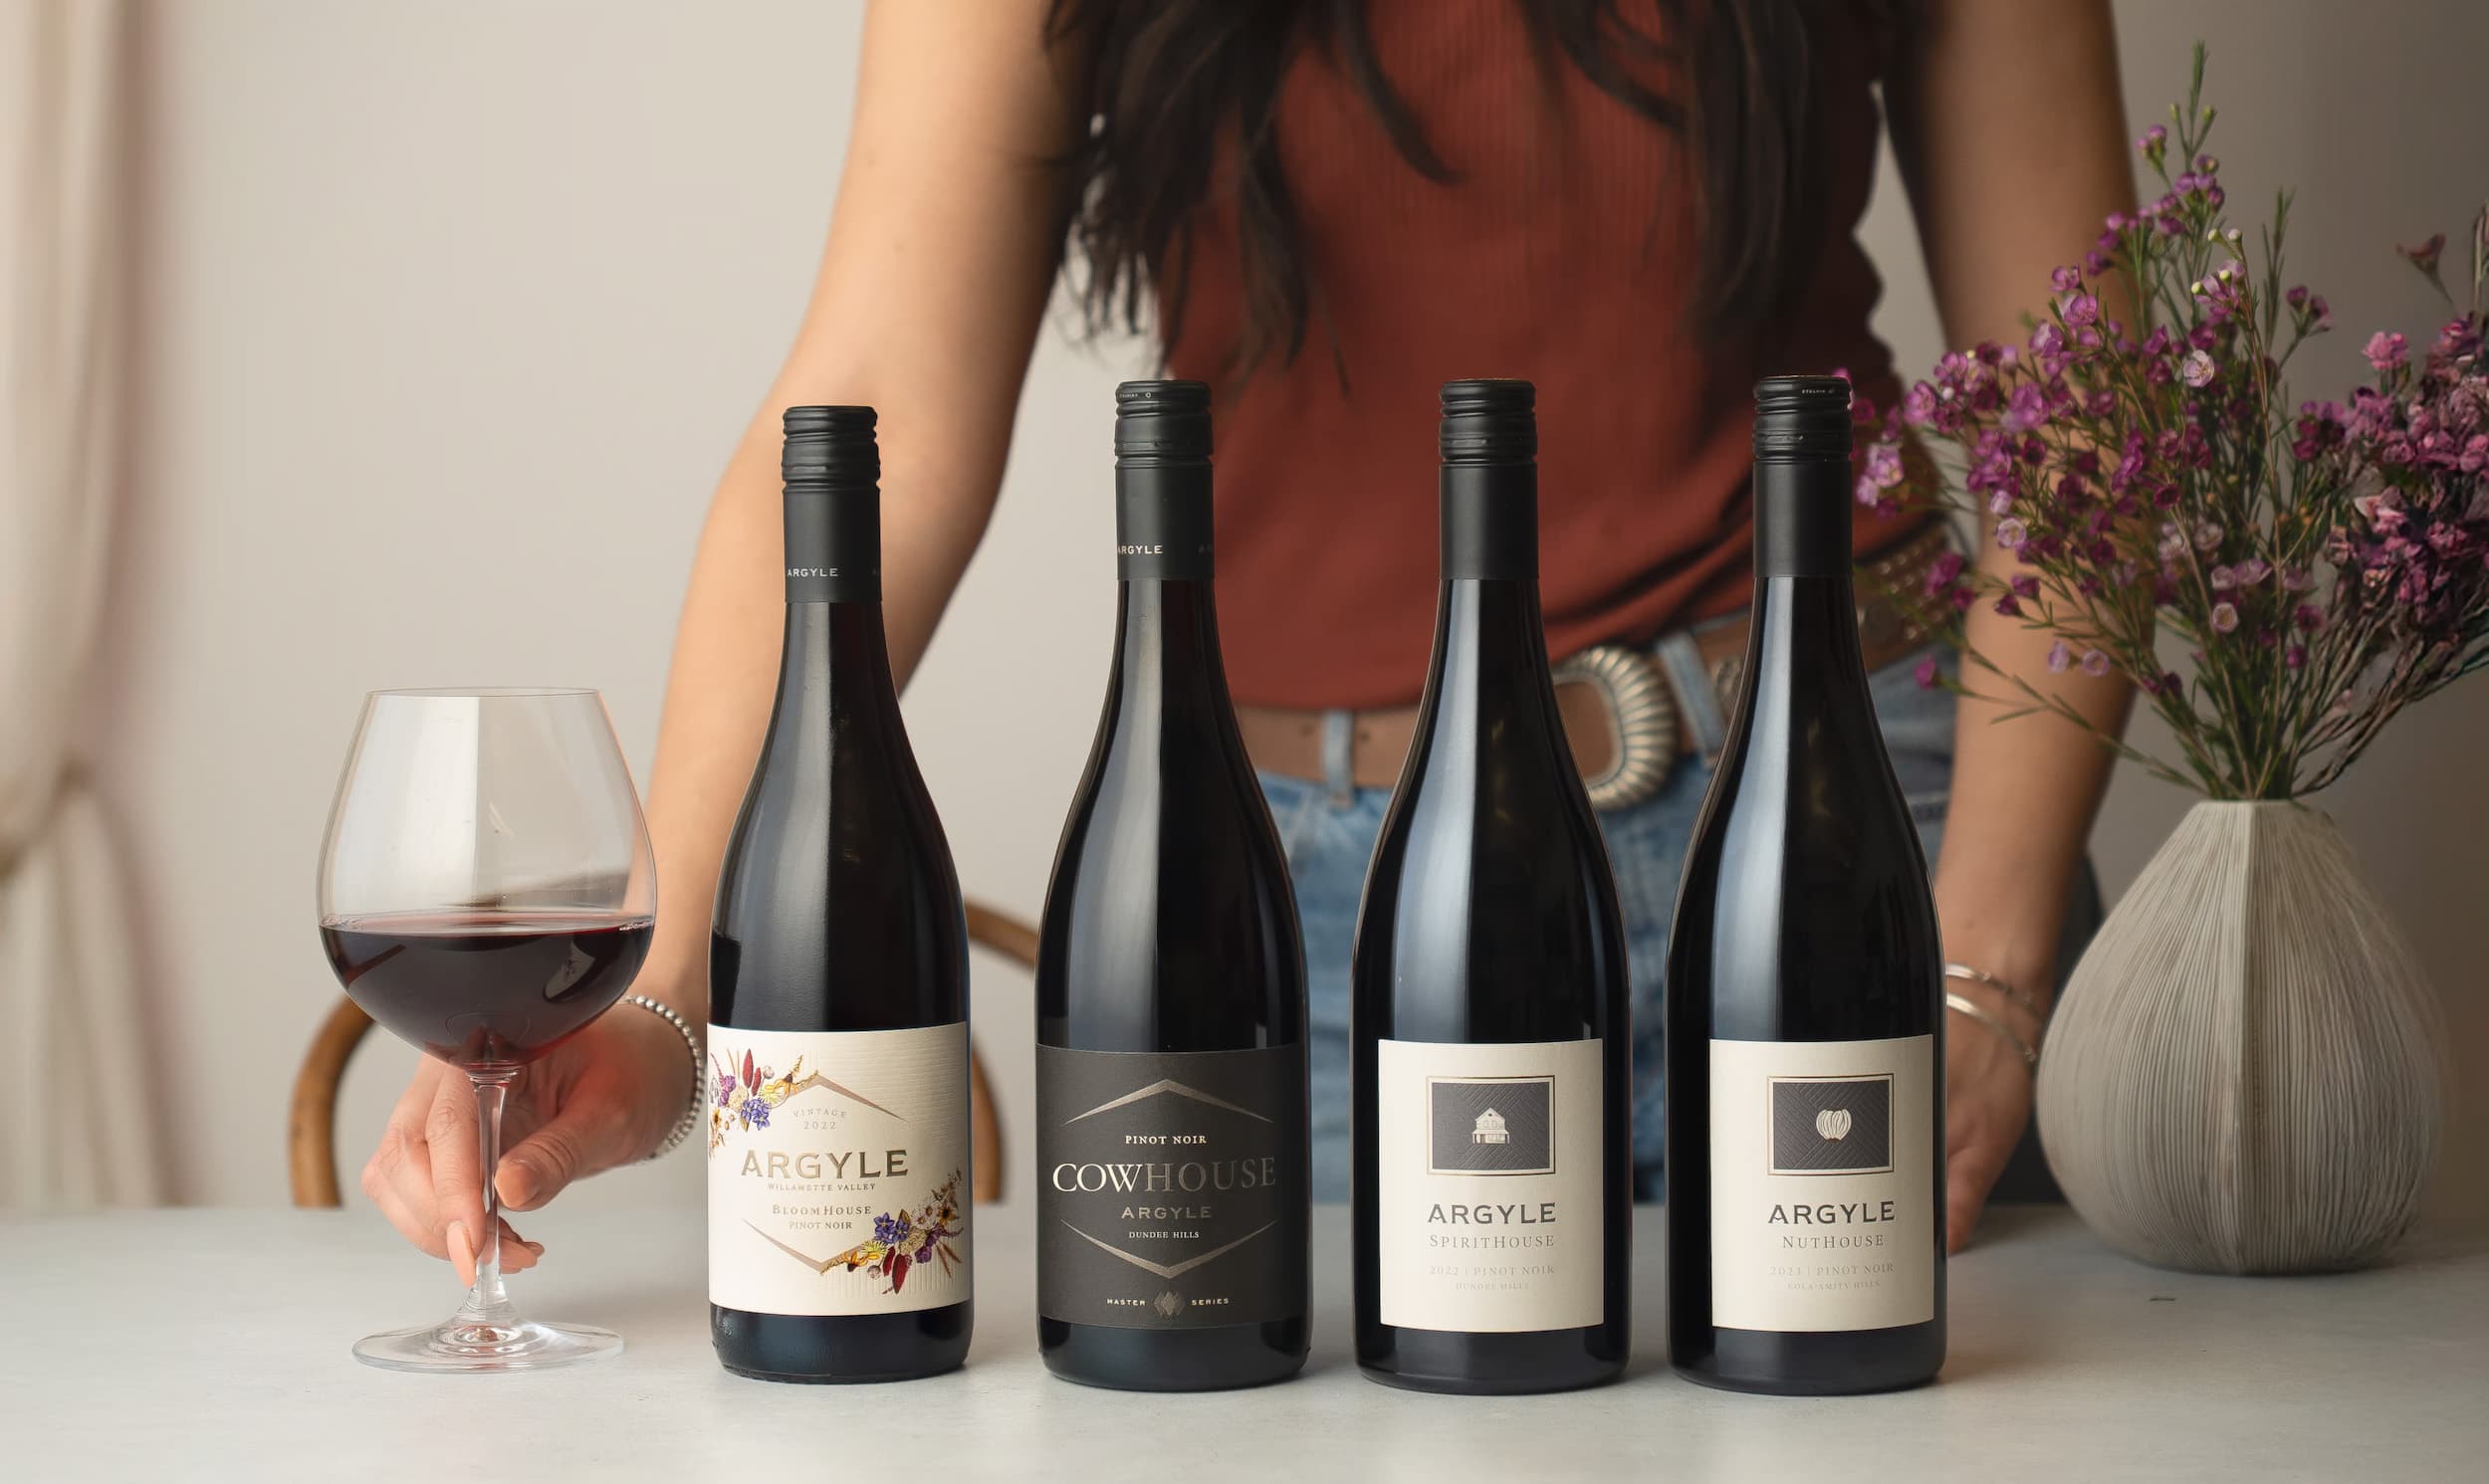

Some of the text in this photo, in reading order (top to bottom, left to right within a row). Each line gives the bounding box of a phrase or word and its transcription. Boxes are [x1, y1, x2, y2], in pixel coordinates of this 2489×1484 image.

[787, 567, 838, 577] ARGYLE
[793, 1108, 846, 1118] VINTAGE
[803, 1121, 837, 1130] 2022
[1125, 1135, 1207, 1145] PINOT NOIR
[741, 1149, 909, 1179] ARGYLE
[1052, 1158, 1275, 1193] COWHOUSE
[837, 1182, 875, 1191] VALLEY
[1121, 1206, 1212, 1219] ARGYLE
[1428, 1202, 1556, 1224] ARGYLE
[1768, 1200, 1896, 1224] ARGYLE
[789, 1220, 852, 1230] PINOT NOIR
[1430, 1234, 1554, 1249] SPIRITHOUSE
[1783, 1234, 1885, 1249] NUTHOUSE
[1473, 1266, 1516, 1276] PINOT
[1521, 1265, 1554, 1275] NOIR
[1816, 1266, 1859, 1275] PINOT
[1863, 1263, 1894, 1275] NOIR
[1106, 1298, 1146, 1307] MASTER
